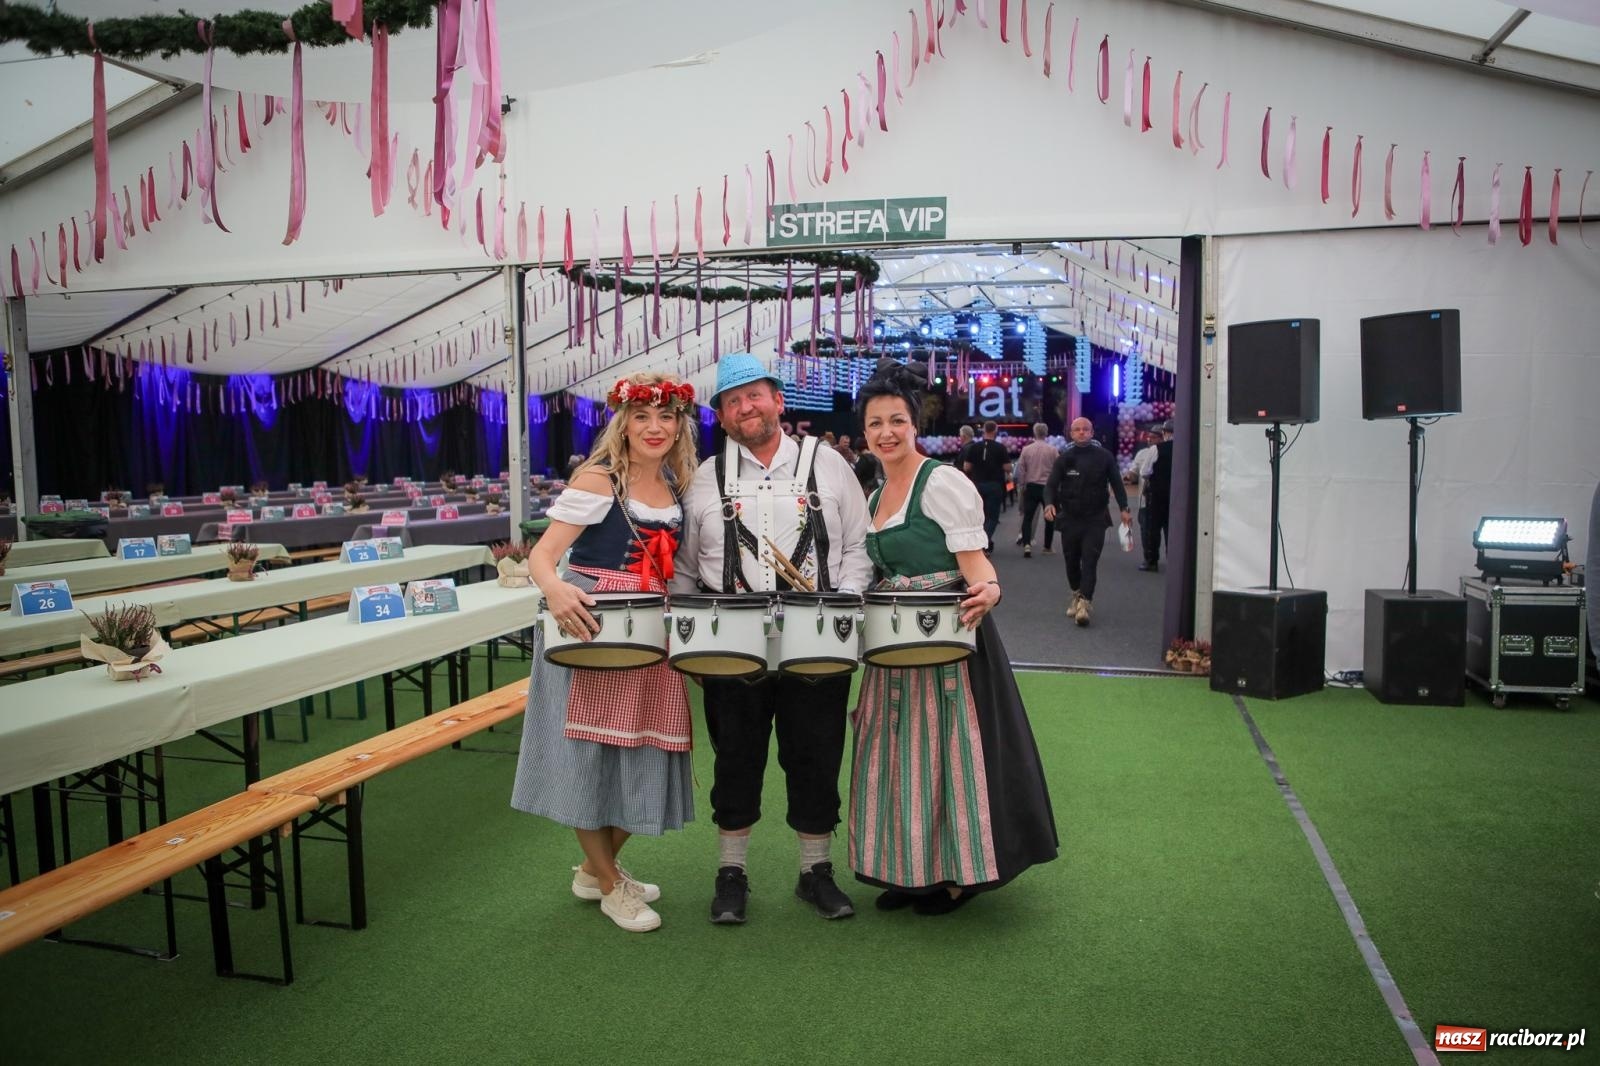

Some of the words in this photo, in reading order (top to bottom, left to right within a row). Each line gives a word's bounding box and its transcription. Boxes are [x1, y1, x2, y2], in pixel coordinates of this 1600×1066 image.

[897, 206, 944, 233] VIP
[968, 375, 1024, 418] lat
[134, 548, 145, 557] 17
[38, 597, 56, 610] 26
[375, 603, 391, 617] 34
